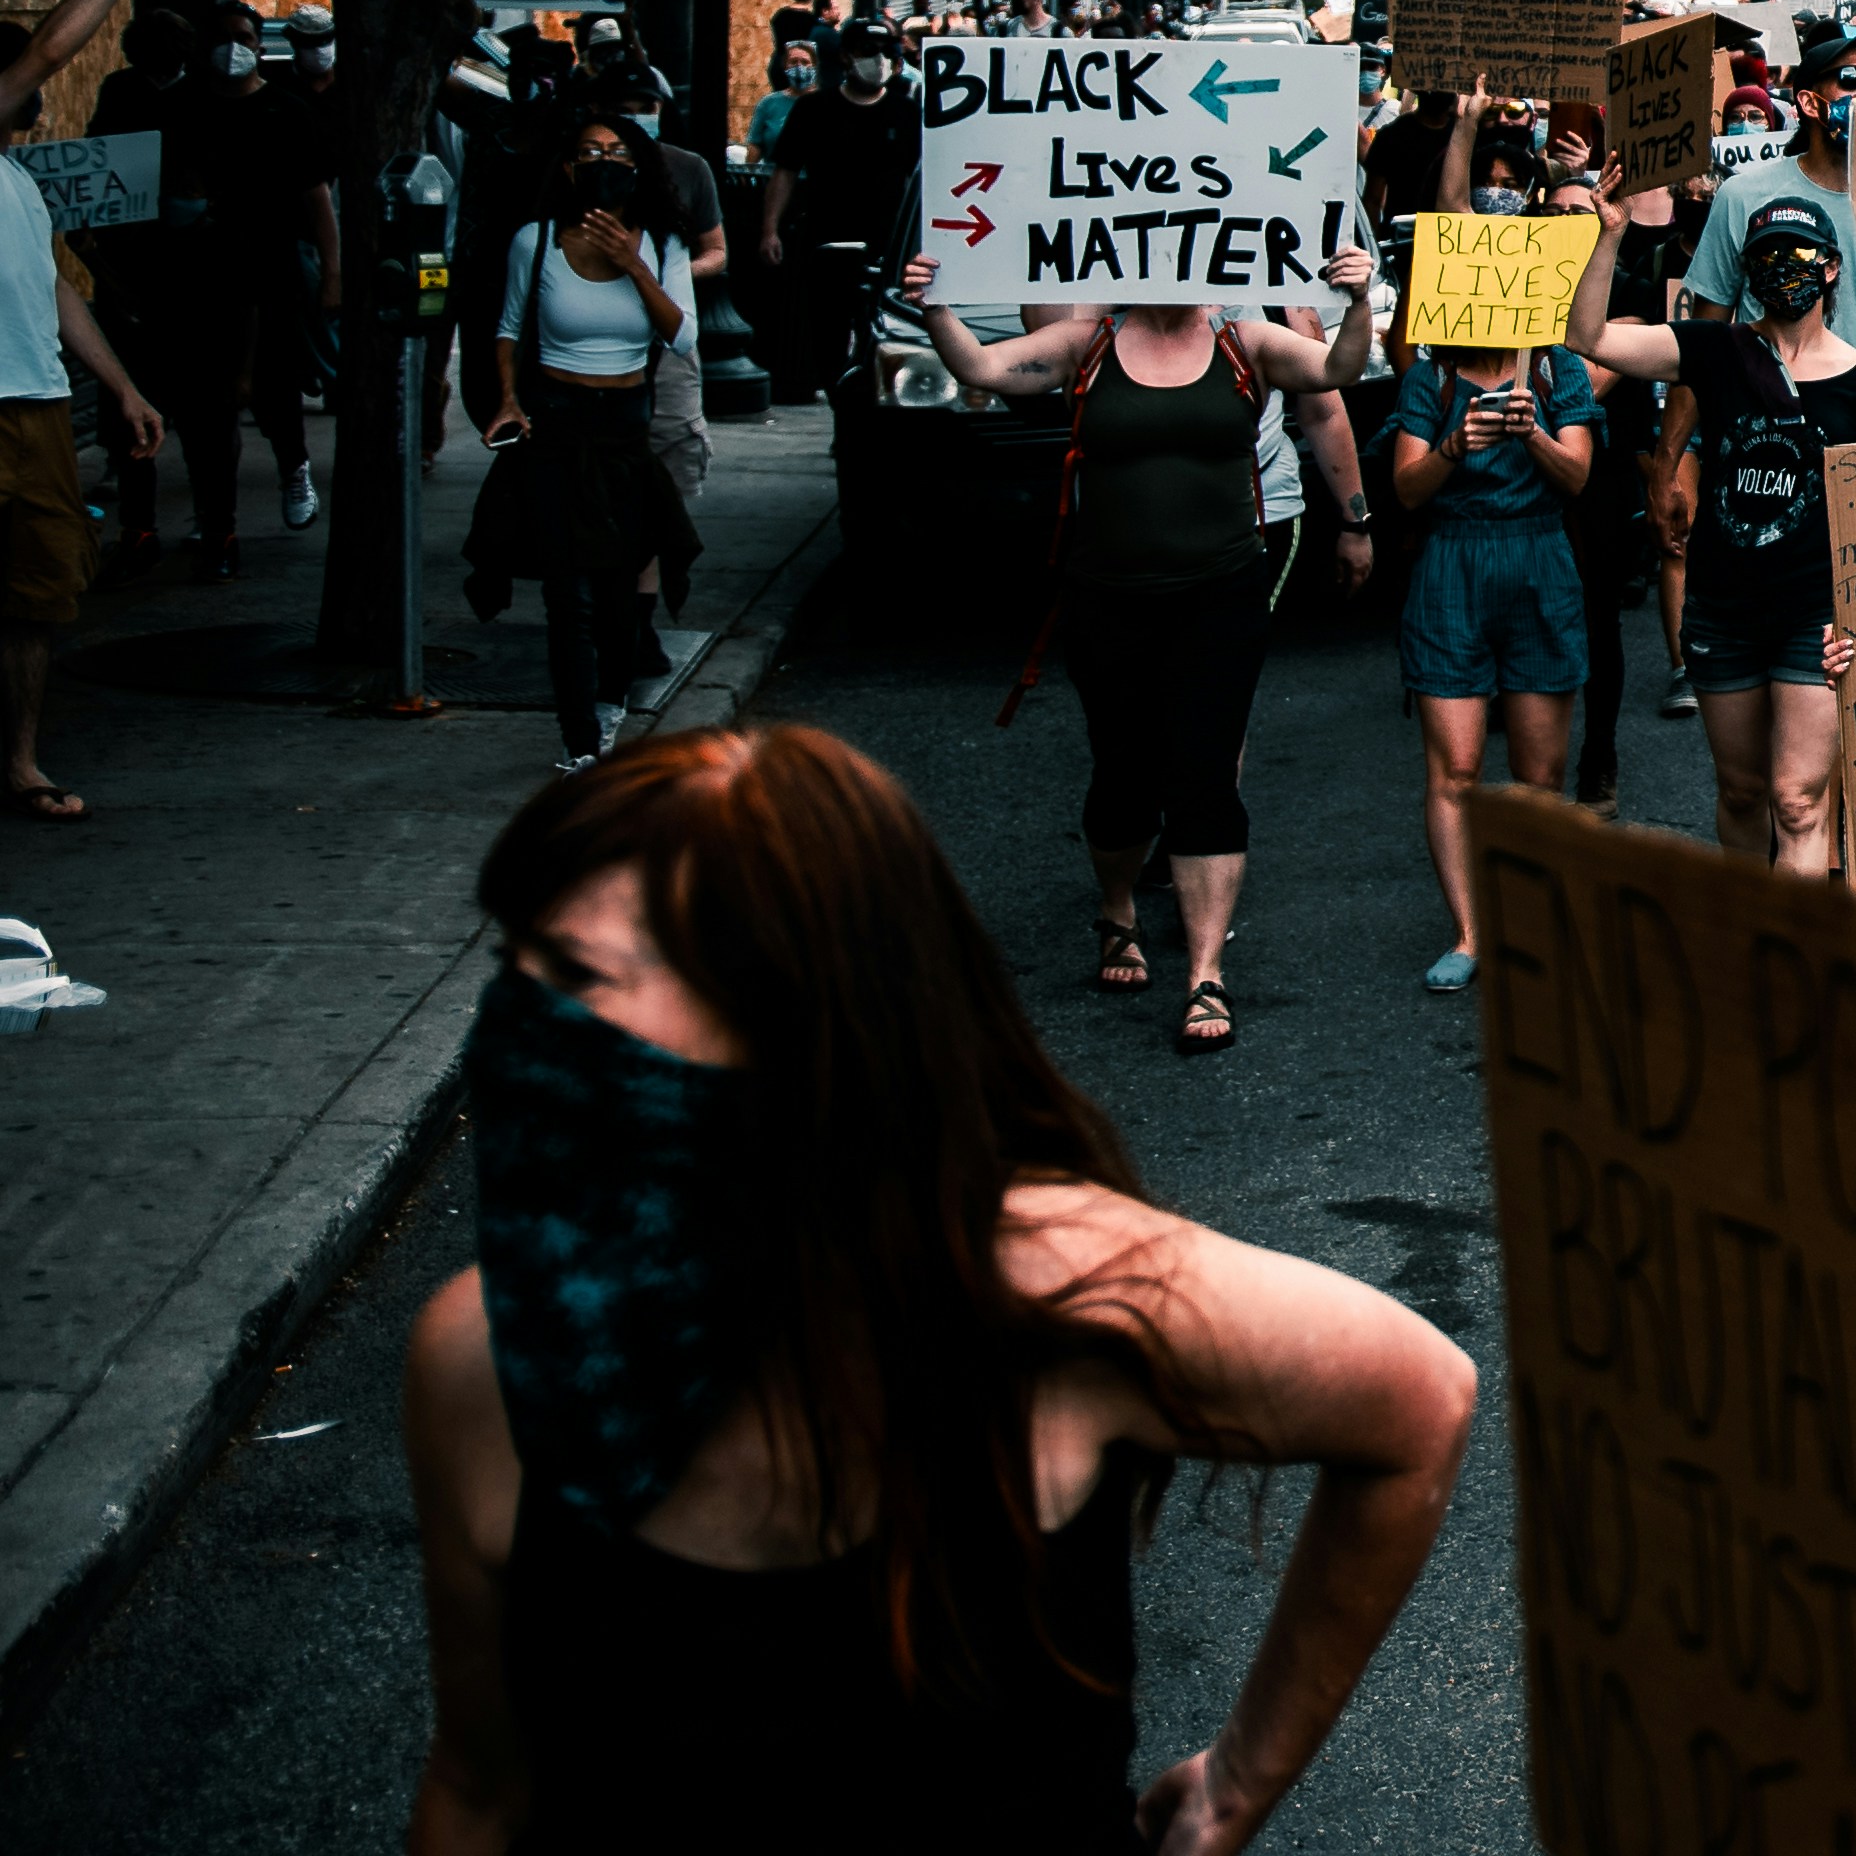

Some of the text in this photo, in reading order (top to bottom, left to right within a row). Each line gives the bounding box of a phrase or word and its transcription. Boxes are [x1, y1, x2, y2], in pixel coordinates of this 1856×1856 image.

[1607, 33, 1690, 95] BLACK
[922, 46, 1169, 129] BLACK
[1627, 84, 1683, 130] LIVES
[16, 137, 107, 174] KIDS
[102, 169, 129, 199] A
[1026, 199, 1348, 288] MATTER!
[1436, 214, 1550, 256] BLACK
[1436, 259, 1578, 301] LIVES
[1411, 300, 1573, 341] MATTER
[1737, 467, 1797, 498] VOLCÁN
[1484, 843, 1705, 1145] END
